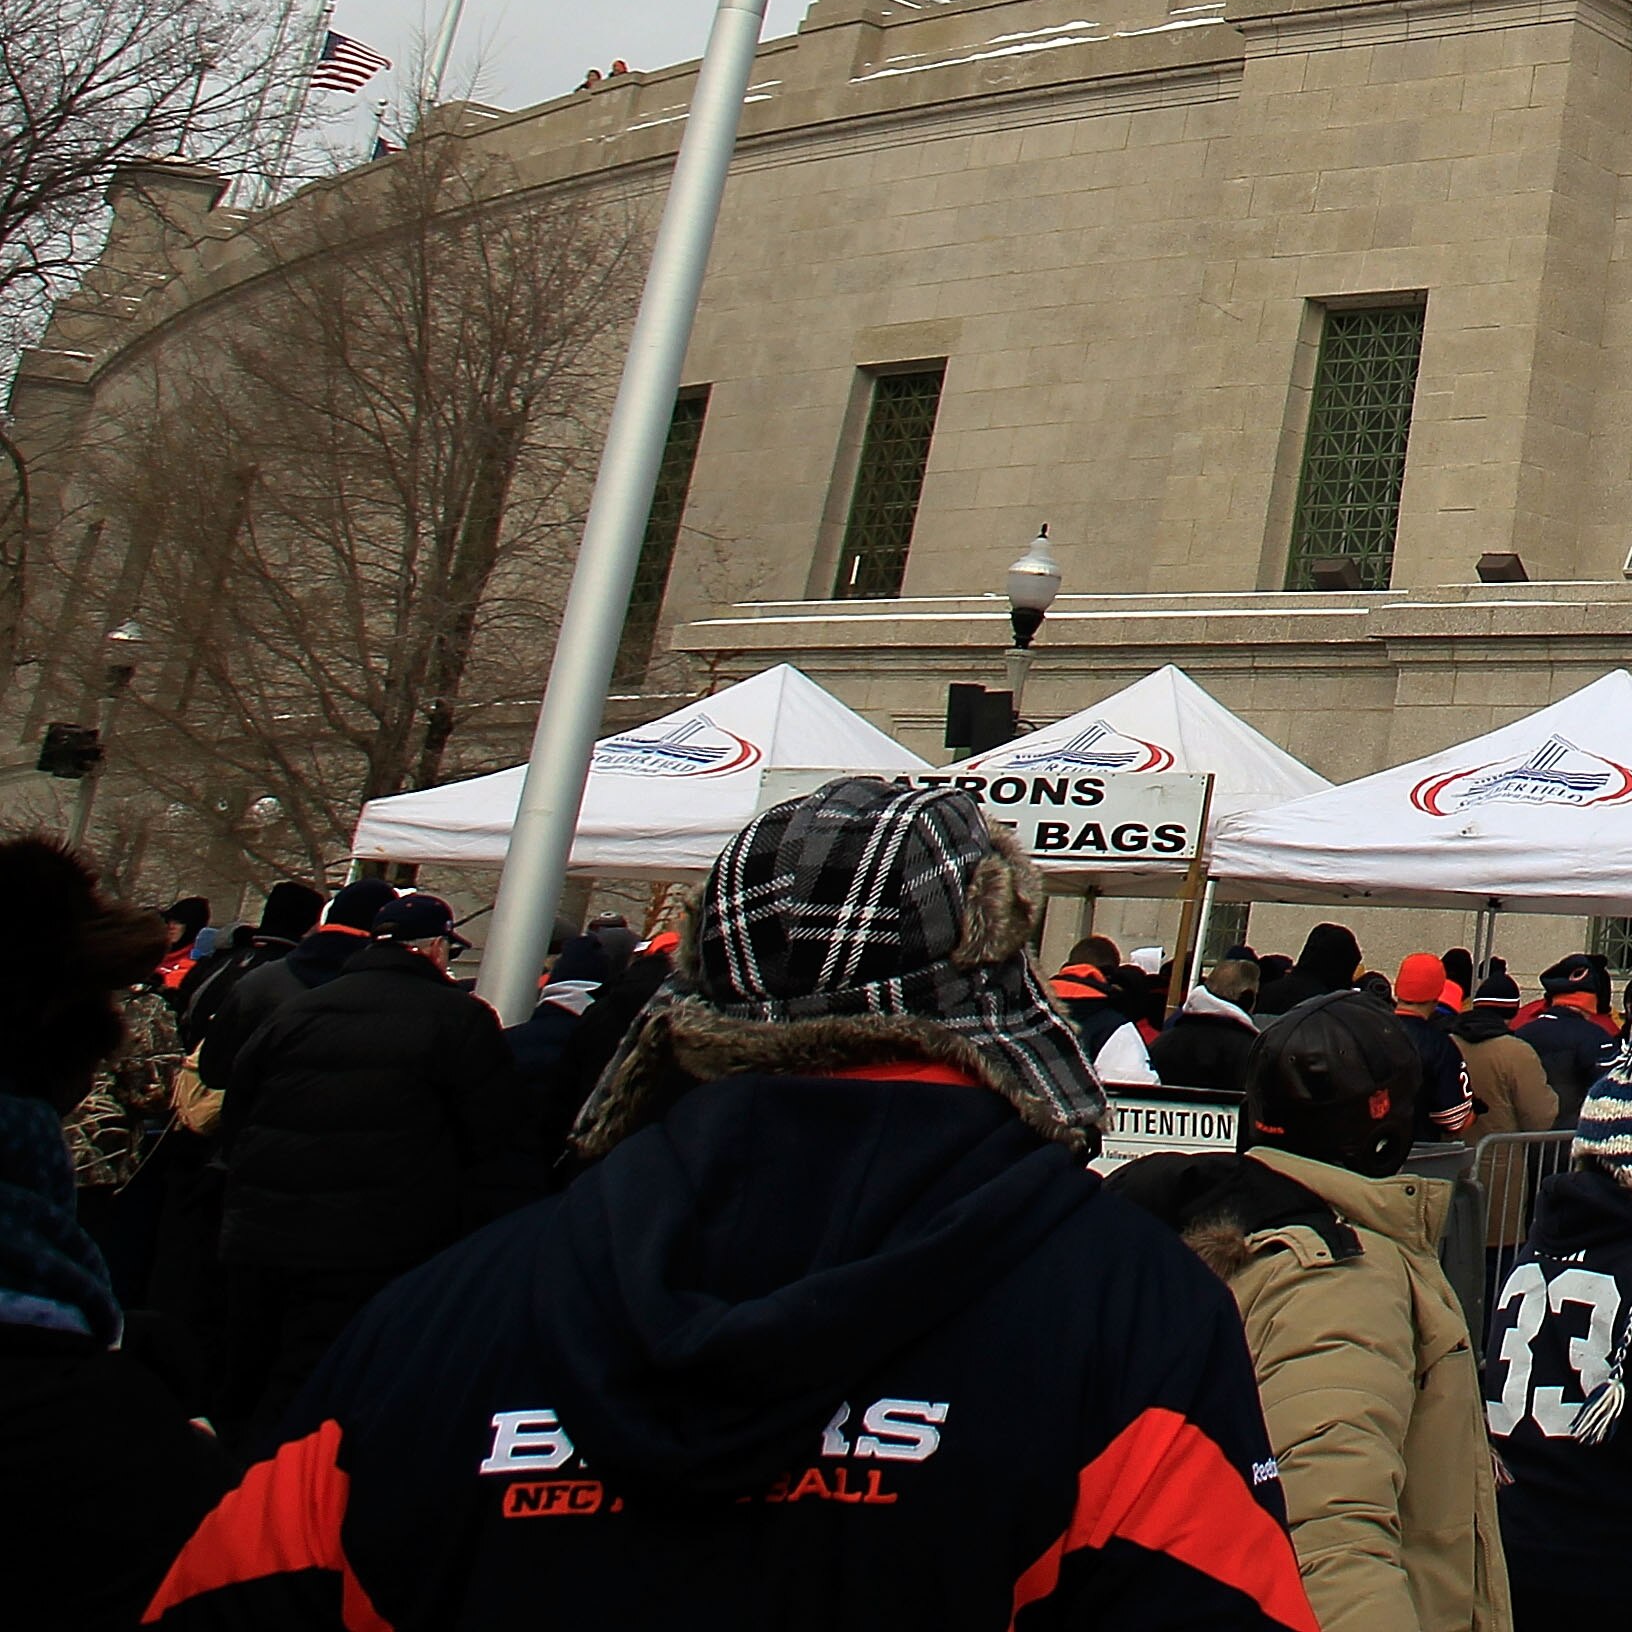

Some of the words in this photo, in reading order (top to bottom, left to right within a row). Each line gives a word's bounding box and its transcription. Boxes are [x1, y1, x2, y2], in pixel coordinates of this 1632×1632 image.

[1034, 822, 1187, 853] BAGS
[1108, 1106, 1232, 1140] TTENTION
[1485, 1262, 1622, 1437] 33
[510, 1483, 599, 1514] NFC
